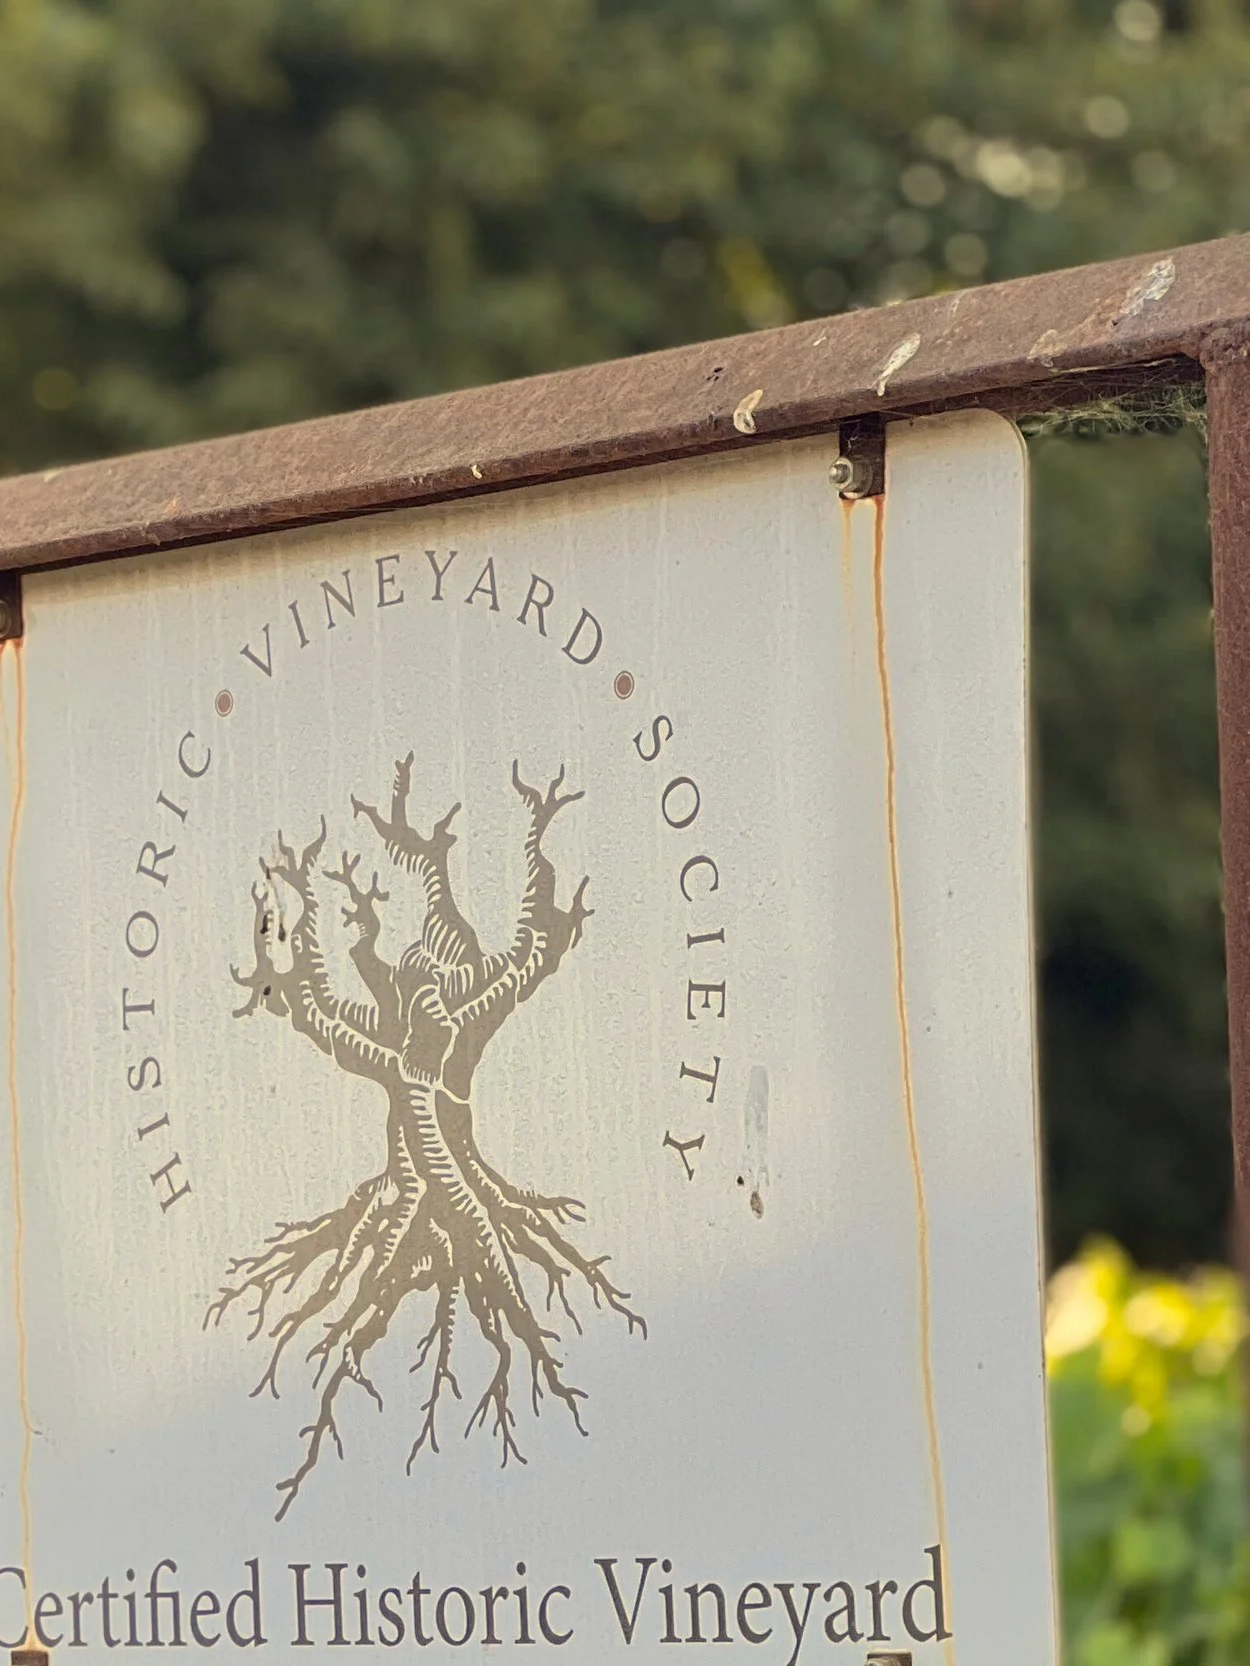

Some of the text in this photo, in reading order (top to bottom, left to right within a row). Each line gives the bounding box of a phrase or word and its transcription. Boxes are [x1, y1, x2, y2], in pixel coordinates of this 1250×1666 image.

[121, 550, 727, 1214] HISTORIC VINEYARD SOCIETY
[288, 1563, 575, 1646] Historic
